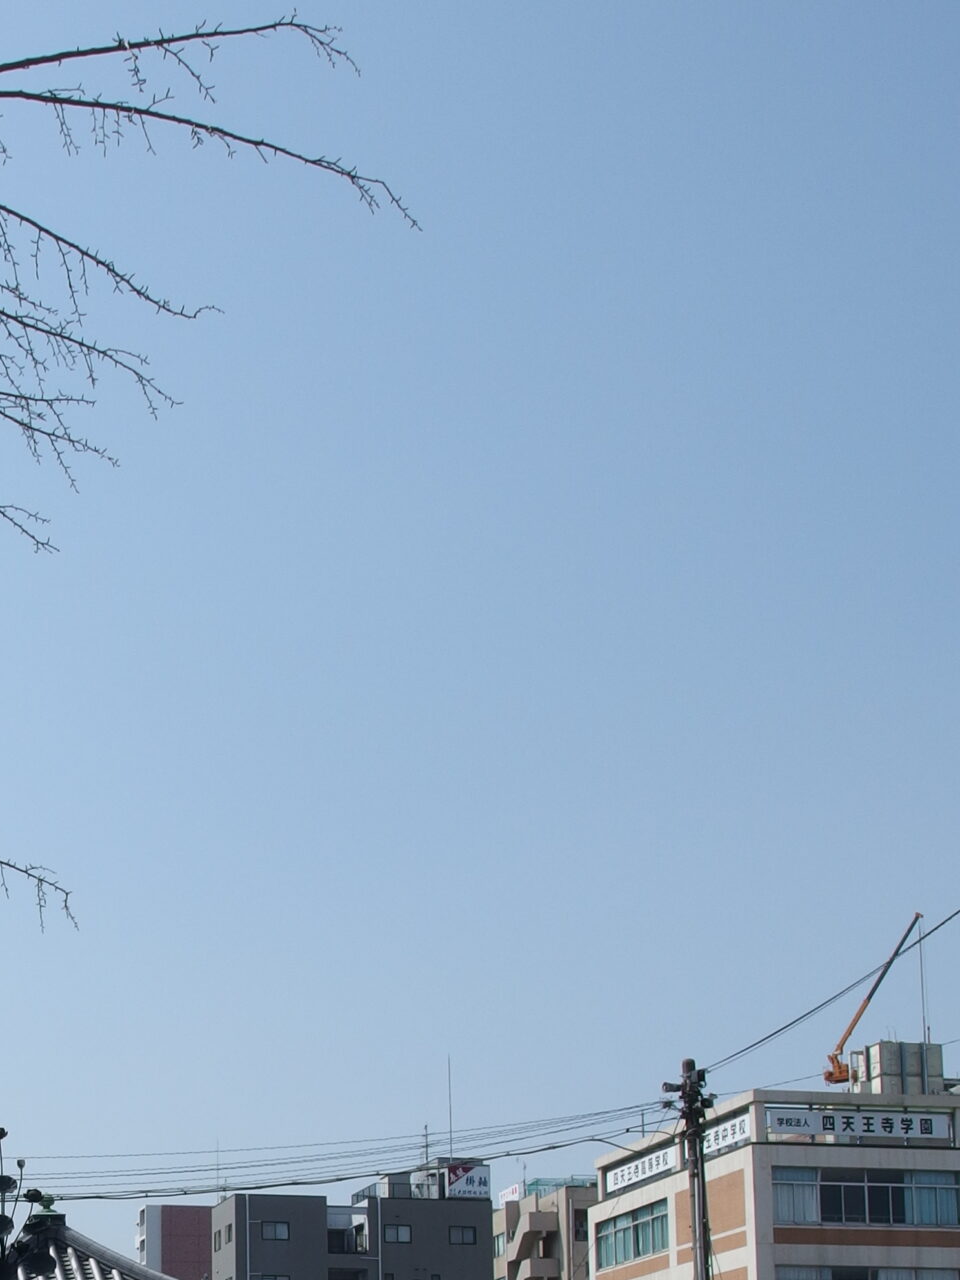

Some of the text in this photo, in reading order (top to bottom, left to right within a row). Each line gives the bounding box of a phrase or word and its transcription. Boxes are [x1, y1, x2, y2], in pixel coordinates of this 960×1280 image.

[776, 1115, 933, 1135] 学校法人 四天王寺学園
[613, 1151, 669, 1186] 四天王寺高等学校
